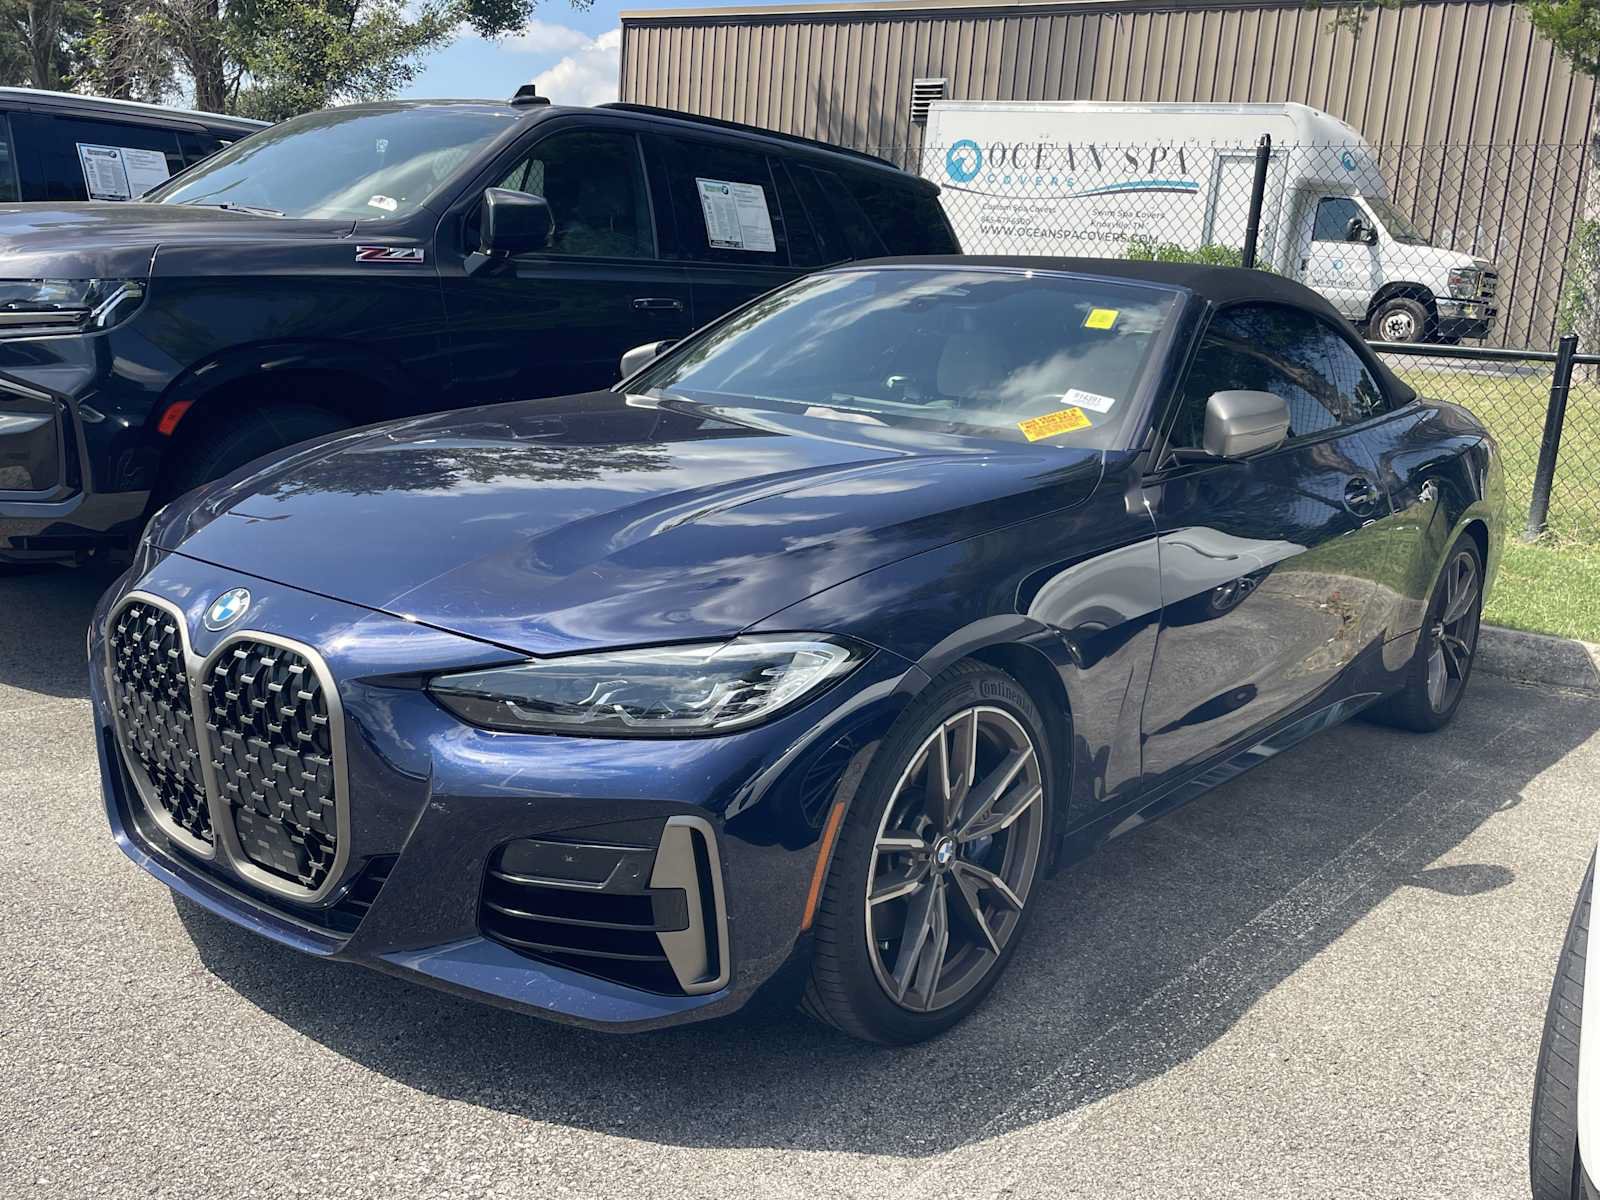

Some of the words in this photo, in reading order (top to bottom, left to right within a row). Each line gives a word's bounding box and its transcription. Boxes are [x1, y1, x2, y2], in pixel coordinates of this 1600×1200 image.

[988, 141, 1106, 172] OCEAN
[1122, 145, 1187, 175] SPA
[986, 172, 1075, 188] COVERS
[1117, 209, 1133, 218] Spa
[1136, 211, 1165, 219] Covers
[980, 224, 1159, 245] WWW.OCEANSPACOVERS.COM
[355, 245, 425, 263] Z71
